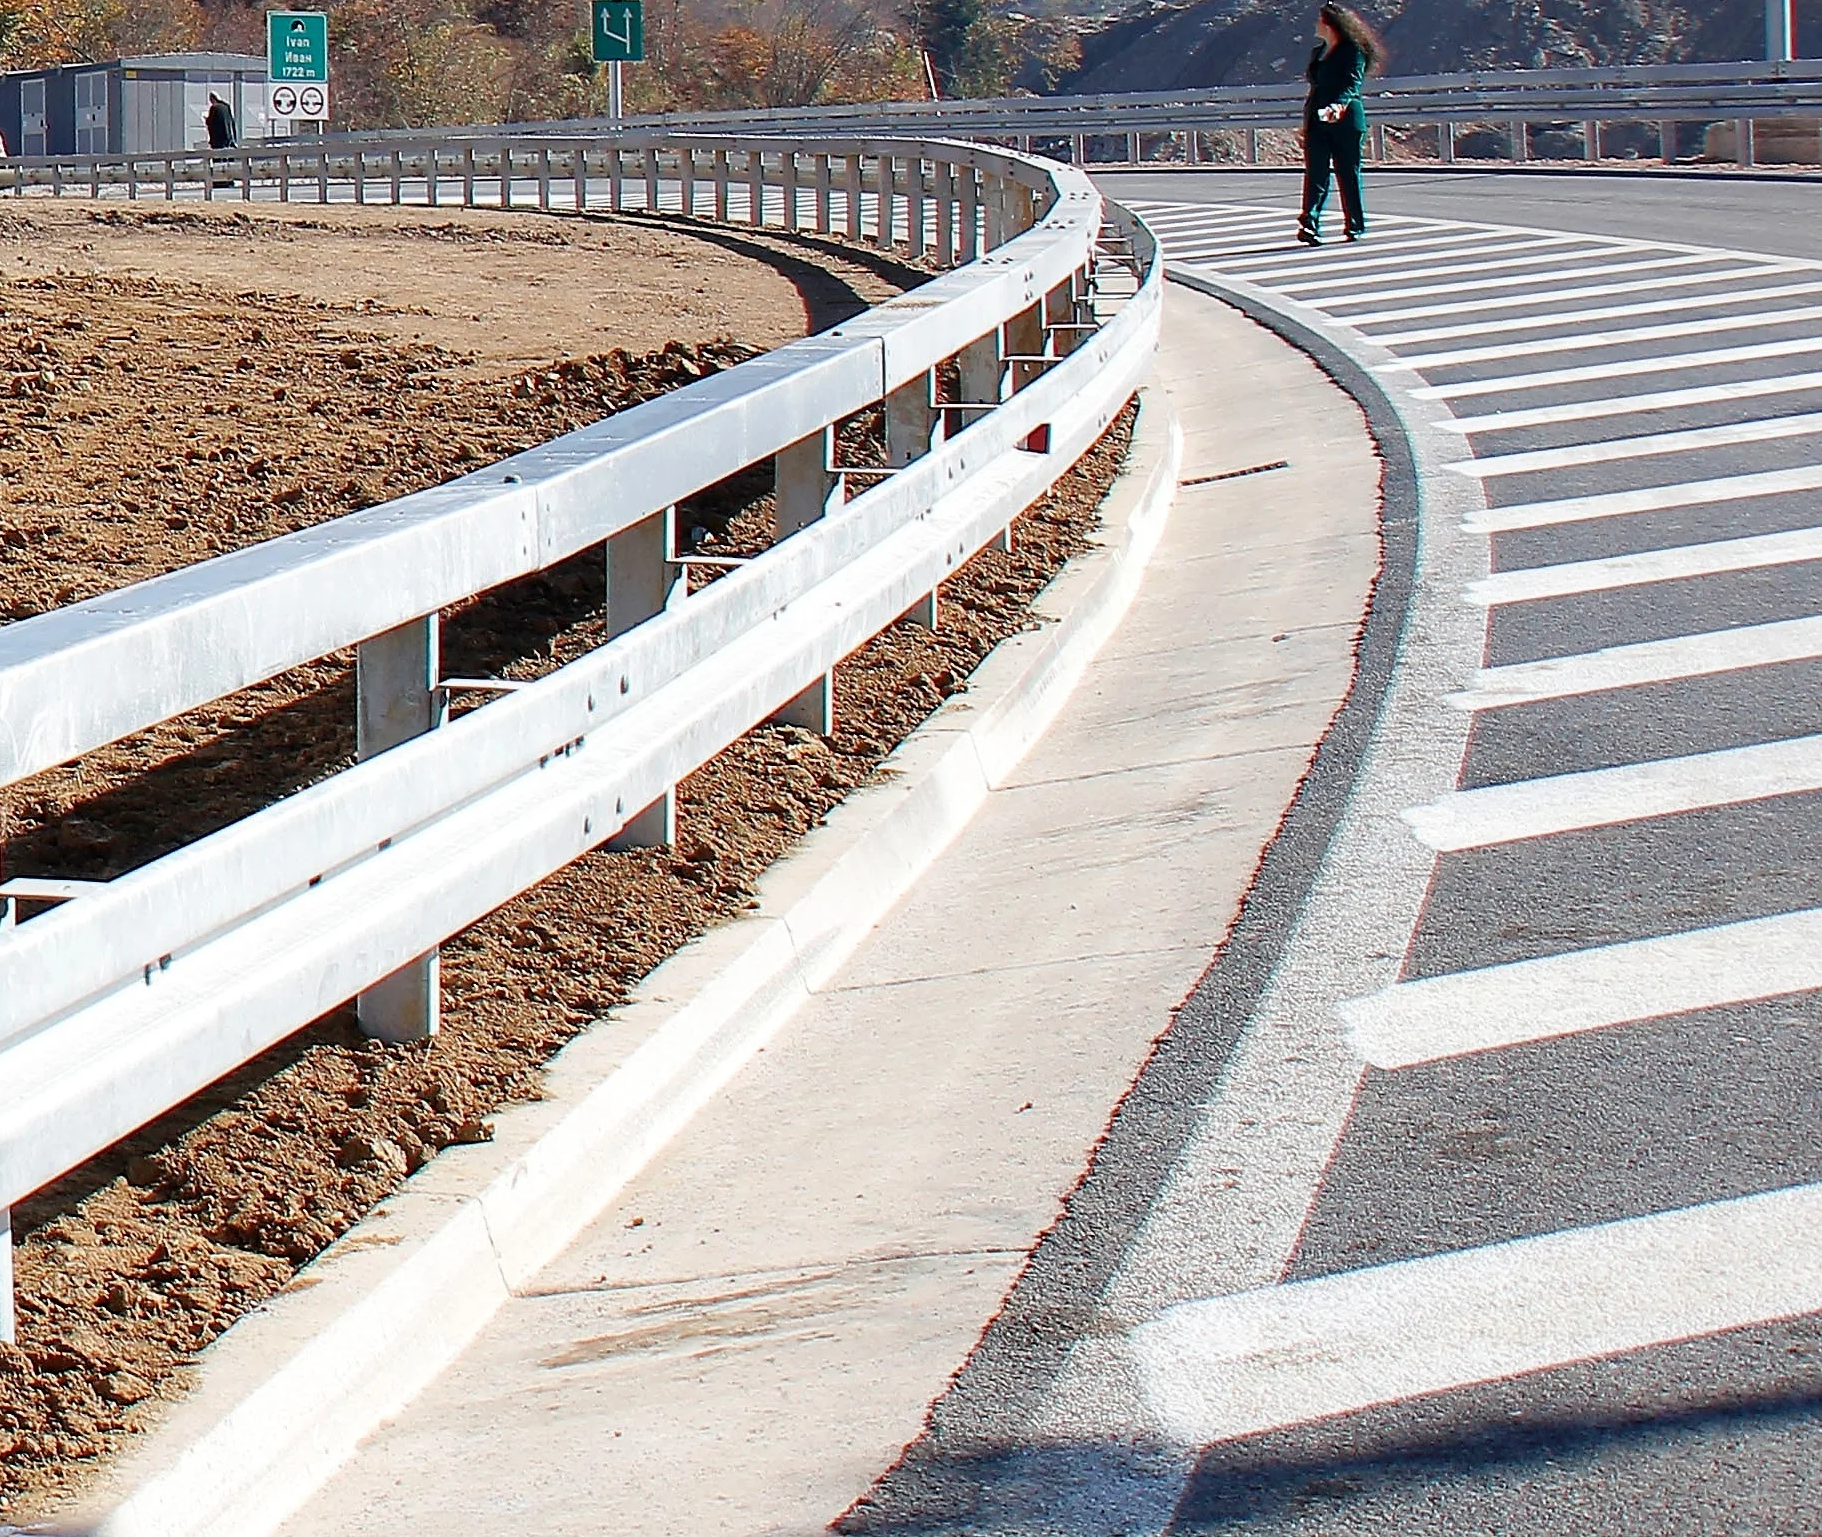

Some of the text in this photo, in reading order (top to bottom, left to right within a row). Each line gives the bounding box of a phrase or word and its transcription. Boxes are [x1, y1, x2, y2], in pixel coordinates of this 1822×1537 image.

[286, 36, 310, 47] Ivan
[282, 67, 315, 78] 1722 m
